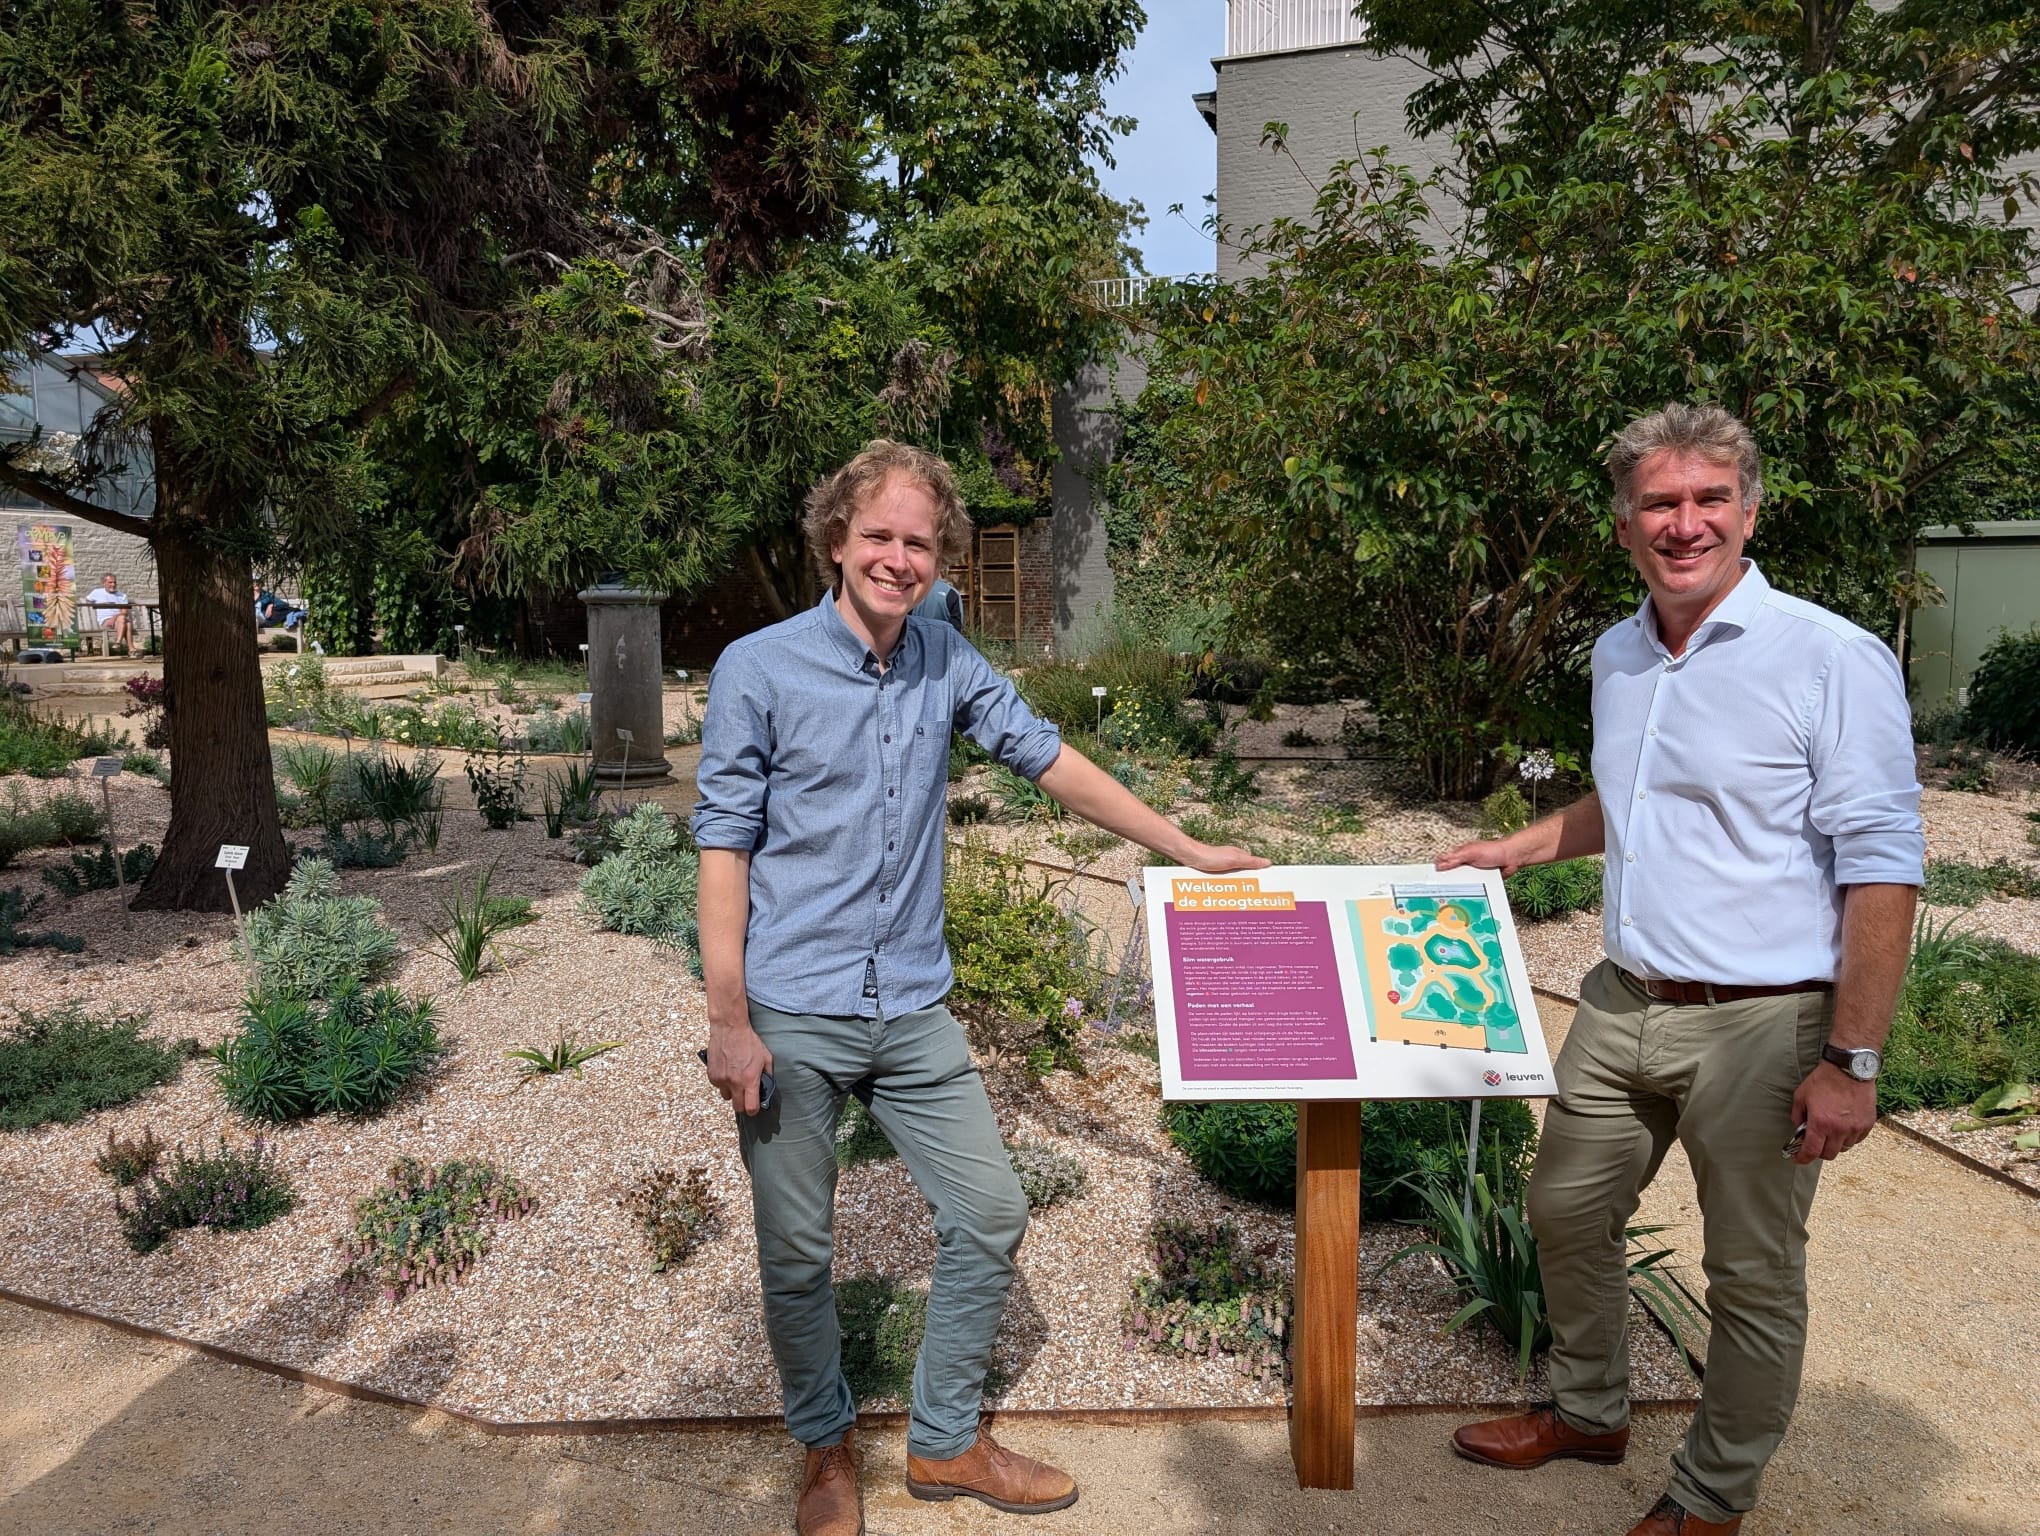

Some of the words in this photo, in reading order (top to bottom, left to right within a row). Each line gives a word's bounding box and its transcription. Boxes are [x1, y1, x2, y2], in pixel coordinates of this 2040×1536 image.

[1176, 881, 1238, 893] Welkom
[1241, 881, 1255, 892] in
[1178, 895, 1198, 907] de
[1202, 895, 1291, 910] droogtetuin
[1505, 1071, 1545, 1081] leuven
